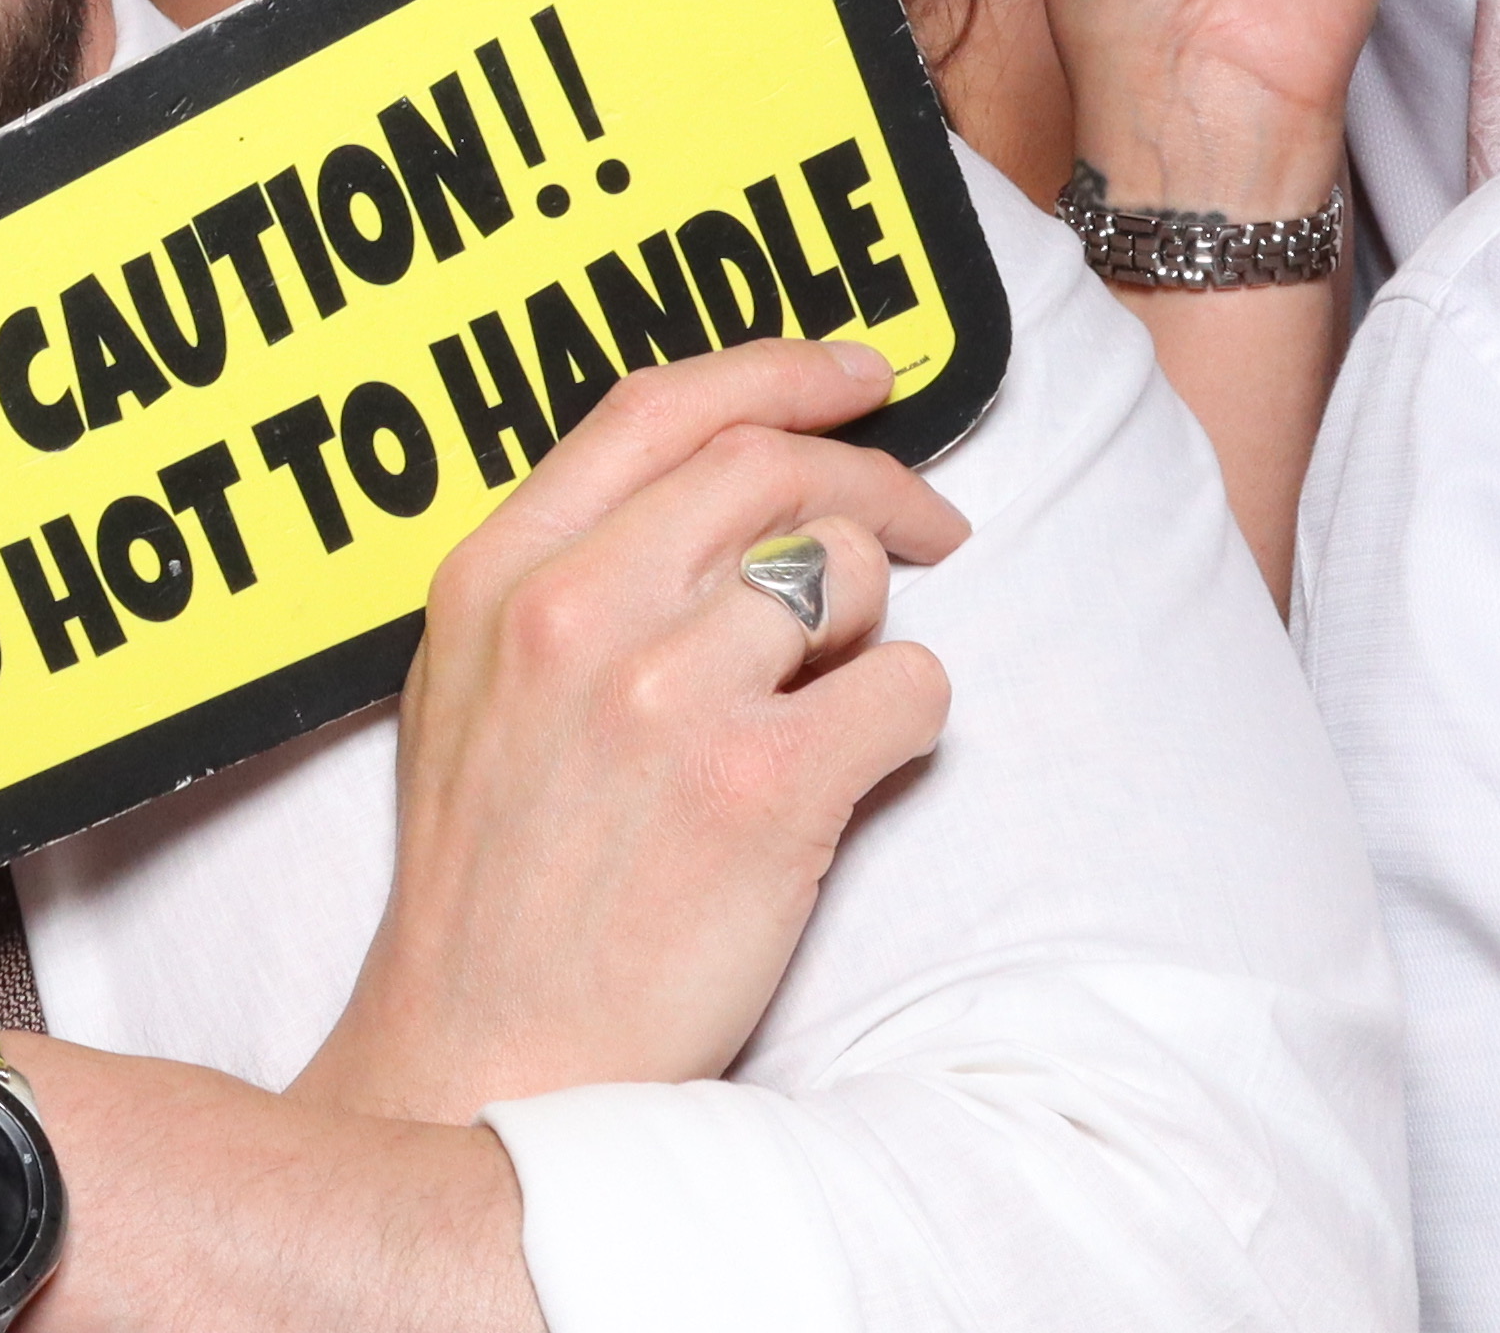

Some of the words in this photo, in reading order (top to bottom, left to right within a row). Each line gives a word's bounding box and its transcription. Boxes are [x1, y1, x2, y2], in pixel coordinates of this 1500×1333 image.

[0, 440, 257, 673] HOT
[252, 381, 439, 554] TO
[429, 138, 919, 490] HANDLE
